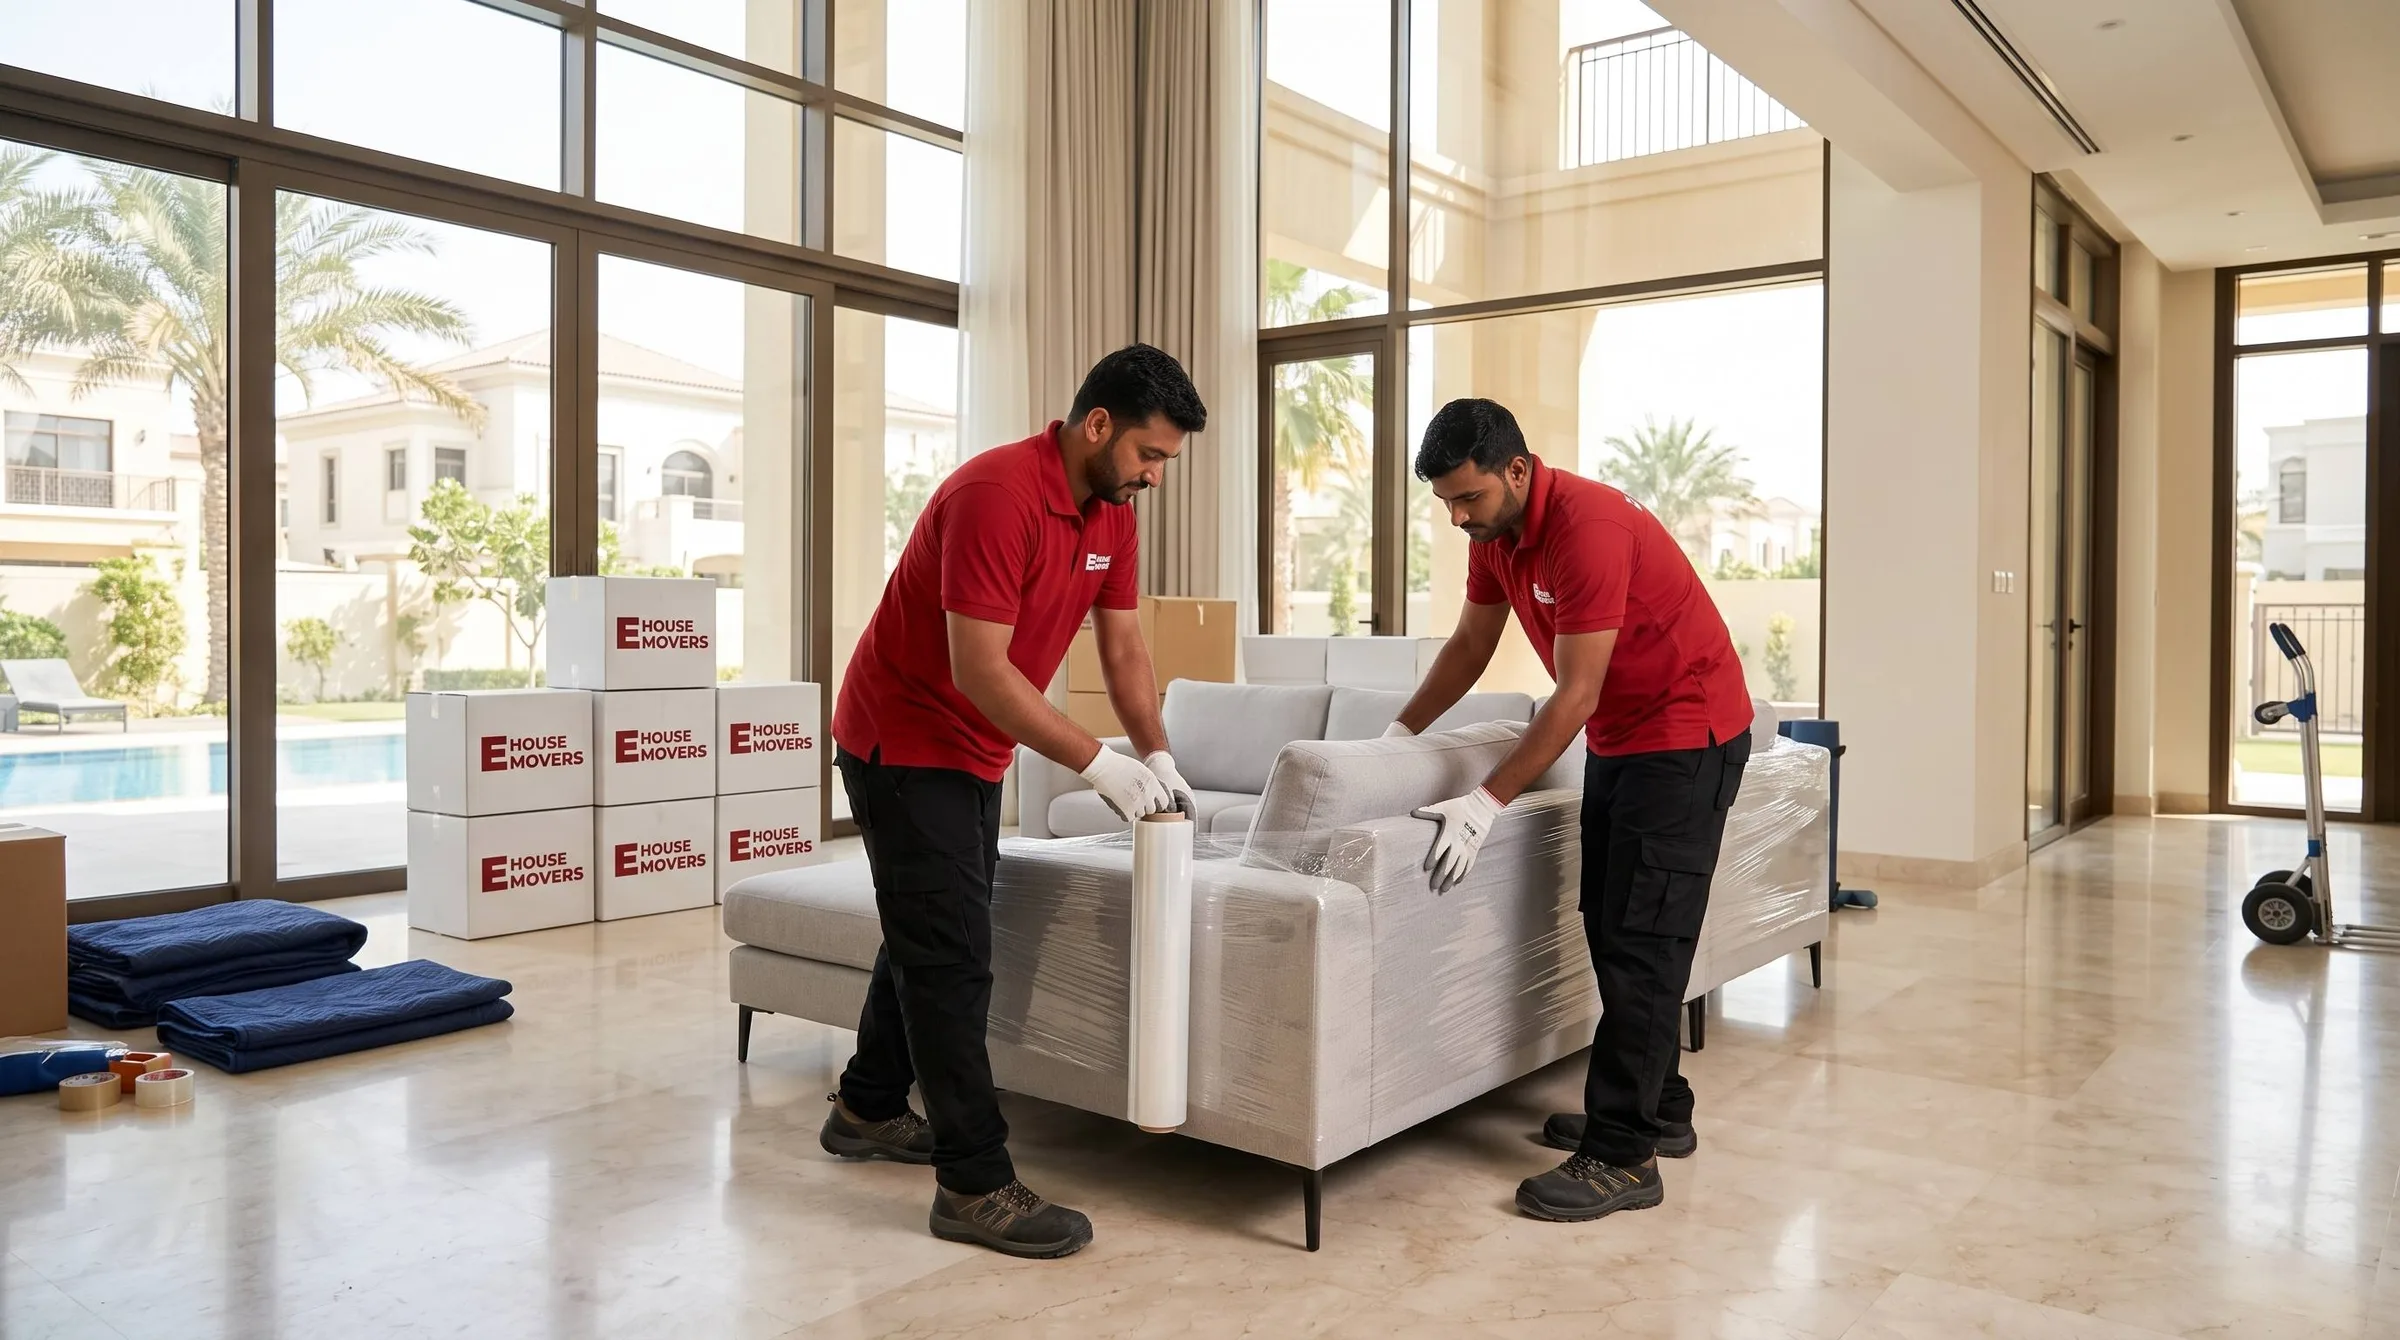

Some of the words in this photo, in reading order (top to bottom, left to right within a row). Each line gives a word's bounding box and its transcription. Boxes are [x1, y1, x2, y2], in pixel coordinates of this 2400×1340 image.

[616, 616, 640, 650] E
[642, 619, 694, 633] HOUSE
[642, 634, 709, 650] MOVERS
[640, 729, 692, 745] HOUSE
[729, 722, 752, 755] E
[752, 722, 800, 737] HOUSE
[510, 735, 568, 750] HOUSE
[615, 729, 639, 764] E
[640, 744, 708, 761] MOVERS
[752, 736, 813, 753] MOVERS
[480, 735, 508, 772] E
[510, 750, 584, 770] MOVERS
[752, 826, 800, 843] HOUSE
[640, 839, 692, 857] HOUSE
[729, 829, 752, 863] E
[752, 839, 813, 859] MOVERS
[510, 851, 568, 872] HOUSE
[614, 842, 639, 878] E
[640, 853, 706, 874] MOVERS
[481, 855, 509, 893] E
[510, 866, 584, 890] MOVERS
